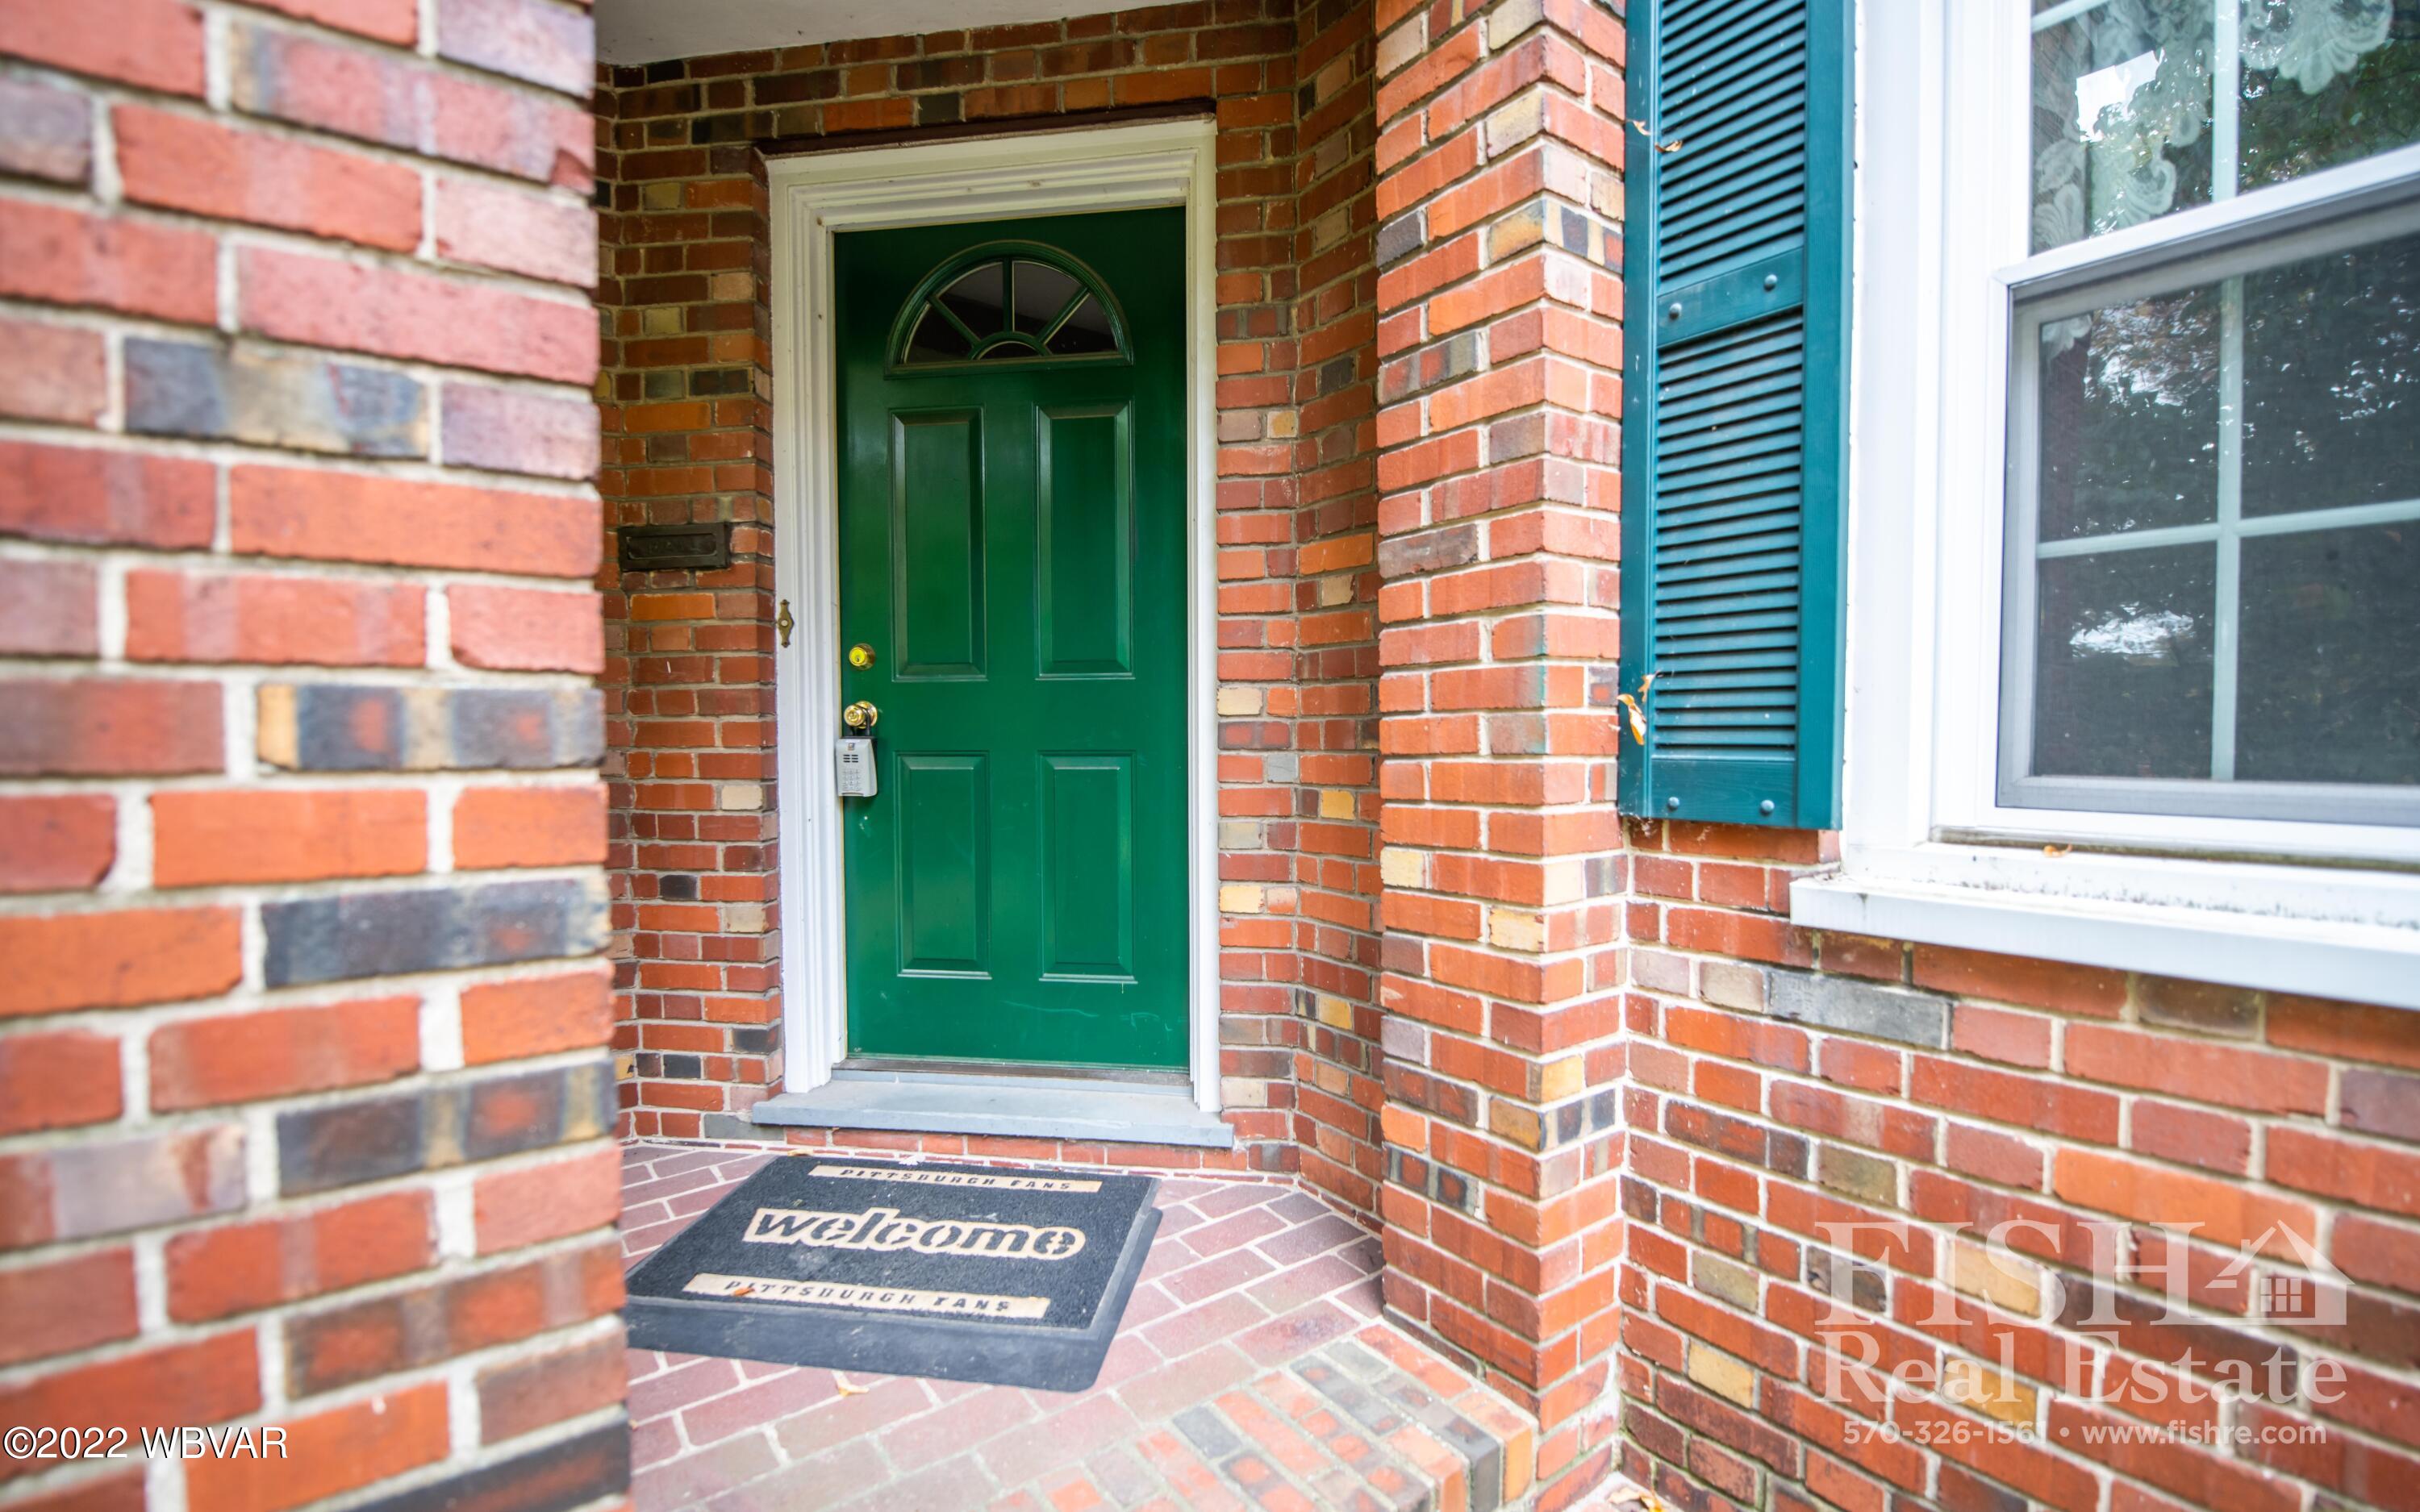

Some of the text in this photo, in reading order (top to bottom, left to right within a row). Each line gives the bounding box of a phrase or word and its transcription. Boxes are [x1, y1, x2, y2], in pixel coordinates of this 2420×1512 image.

[840, 1168, 1071, 1190] PITTSBURGH FANS
[752, 1212, 1076, 1256] welcome
